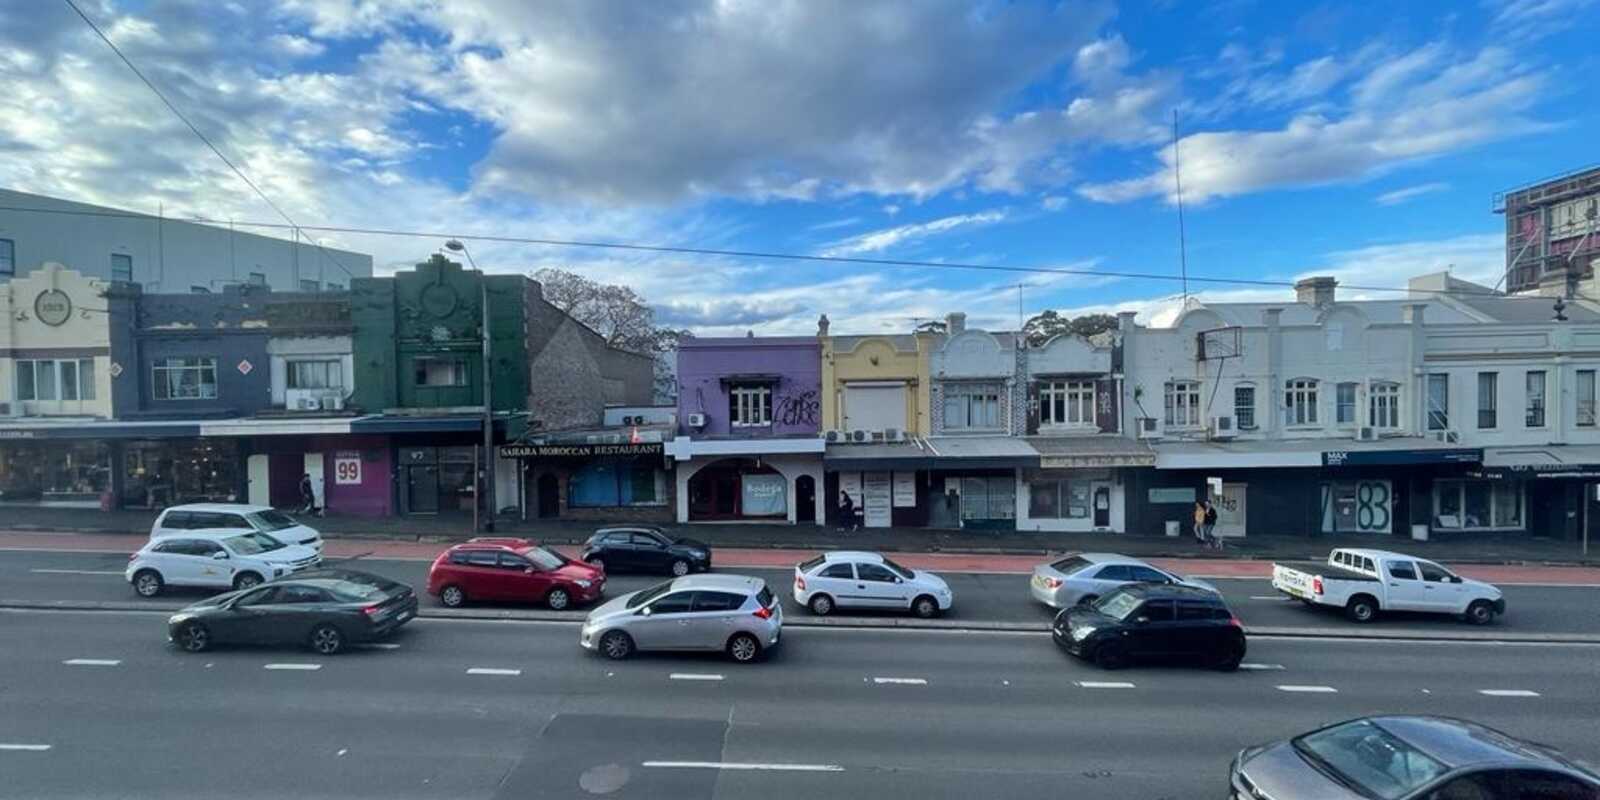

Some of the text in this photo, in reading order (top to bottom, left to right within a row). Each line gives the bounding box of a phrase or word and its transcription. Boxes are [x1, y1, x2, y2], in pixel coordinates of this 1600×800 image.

[501, 445, 661, 457] SAHARA MOROCCAN RESTAURANT
[338, 462, 358, 480] 99
[1359, 482, 1389, 530] 83
